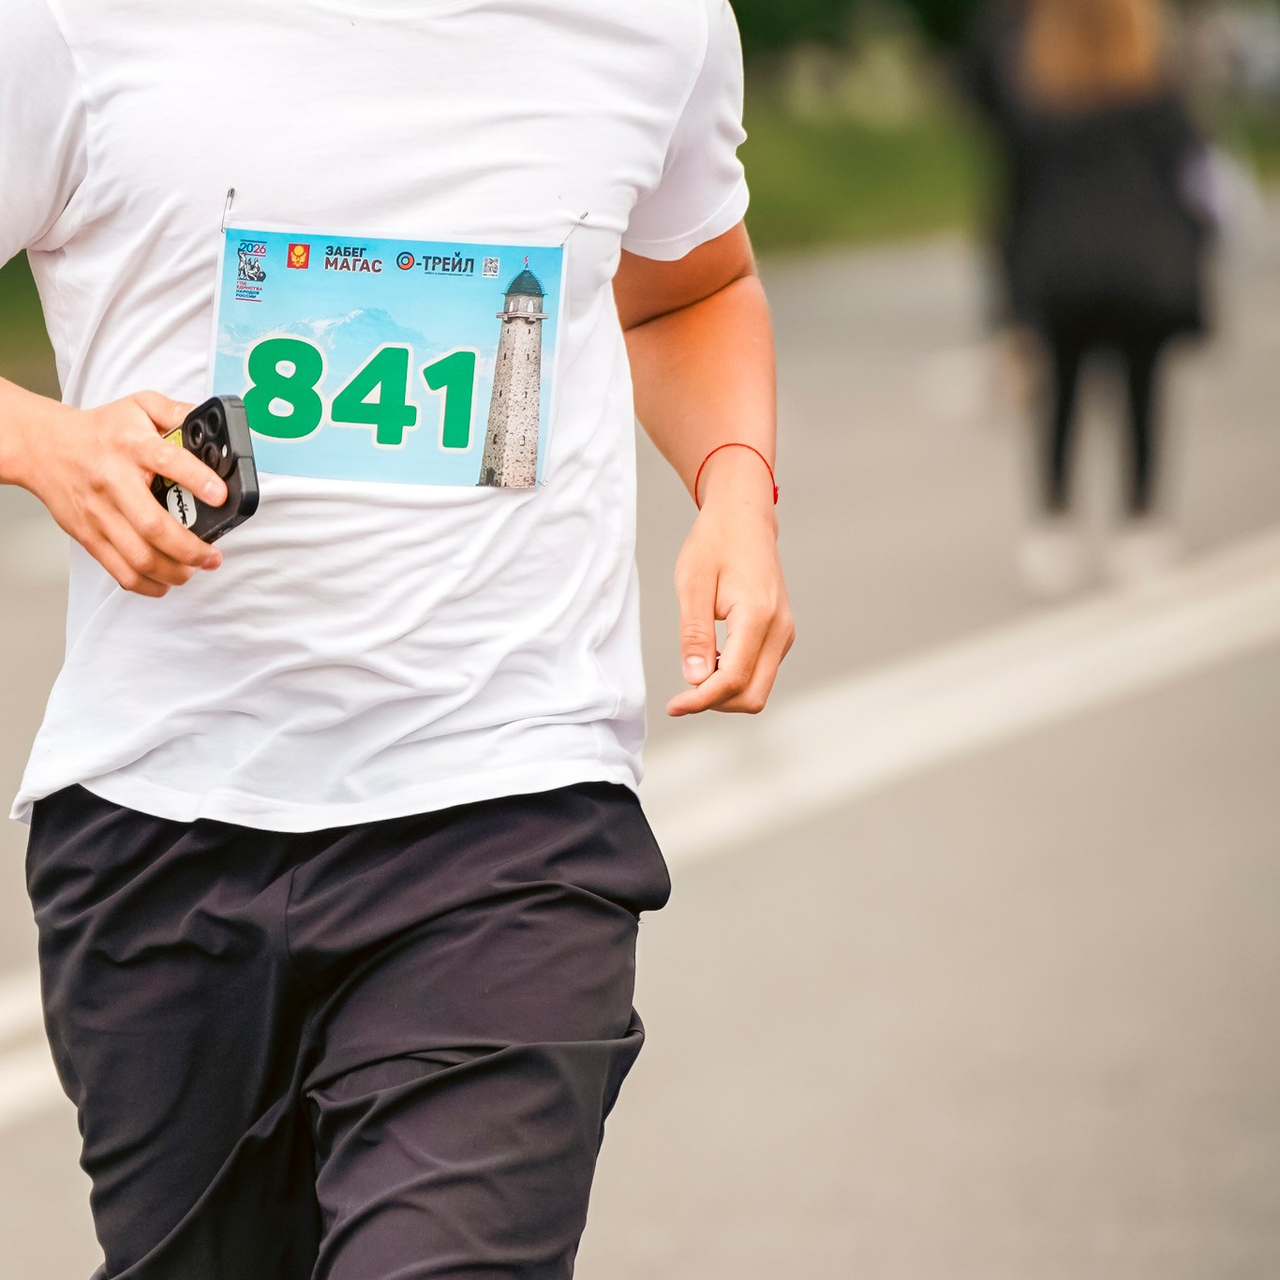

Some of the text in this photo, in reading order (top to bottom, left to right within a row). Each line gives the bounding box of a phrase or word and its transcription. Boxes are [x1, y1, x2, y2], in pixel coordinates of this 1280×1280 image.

[240, 242, 266, 254] 2026
[325, 245, 367, 258] ЗАБЕГ
[324, 257, 383, 273] МАГАС
[243, 337, 477, 449] 841
